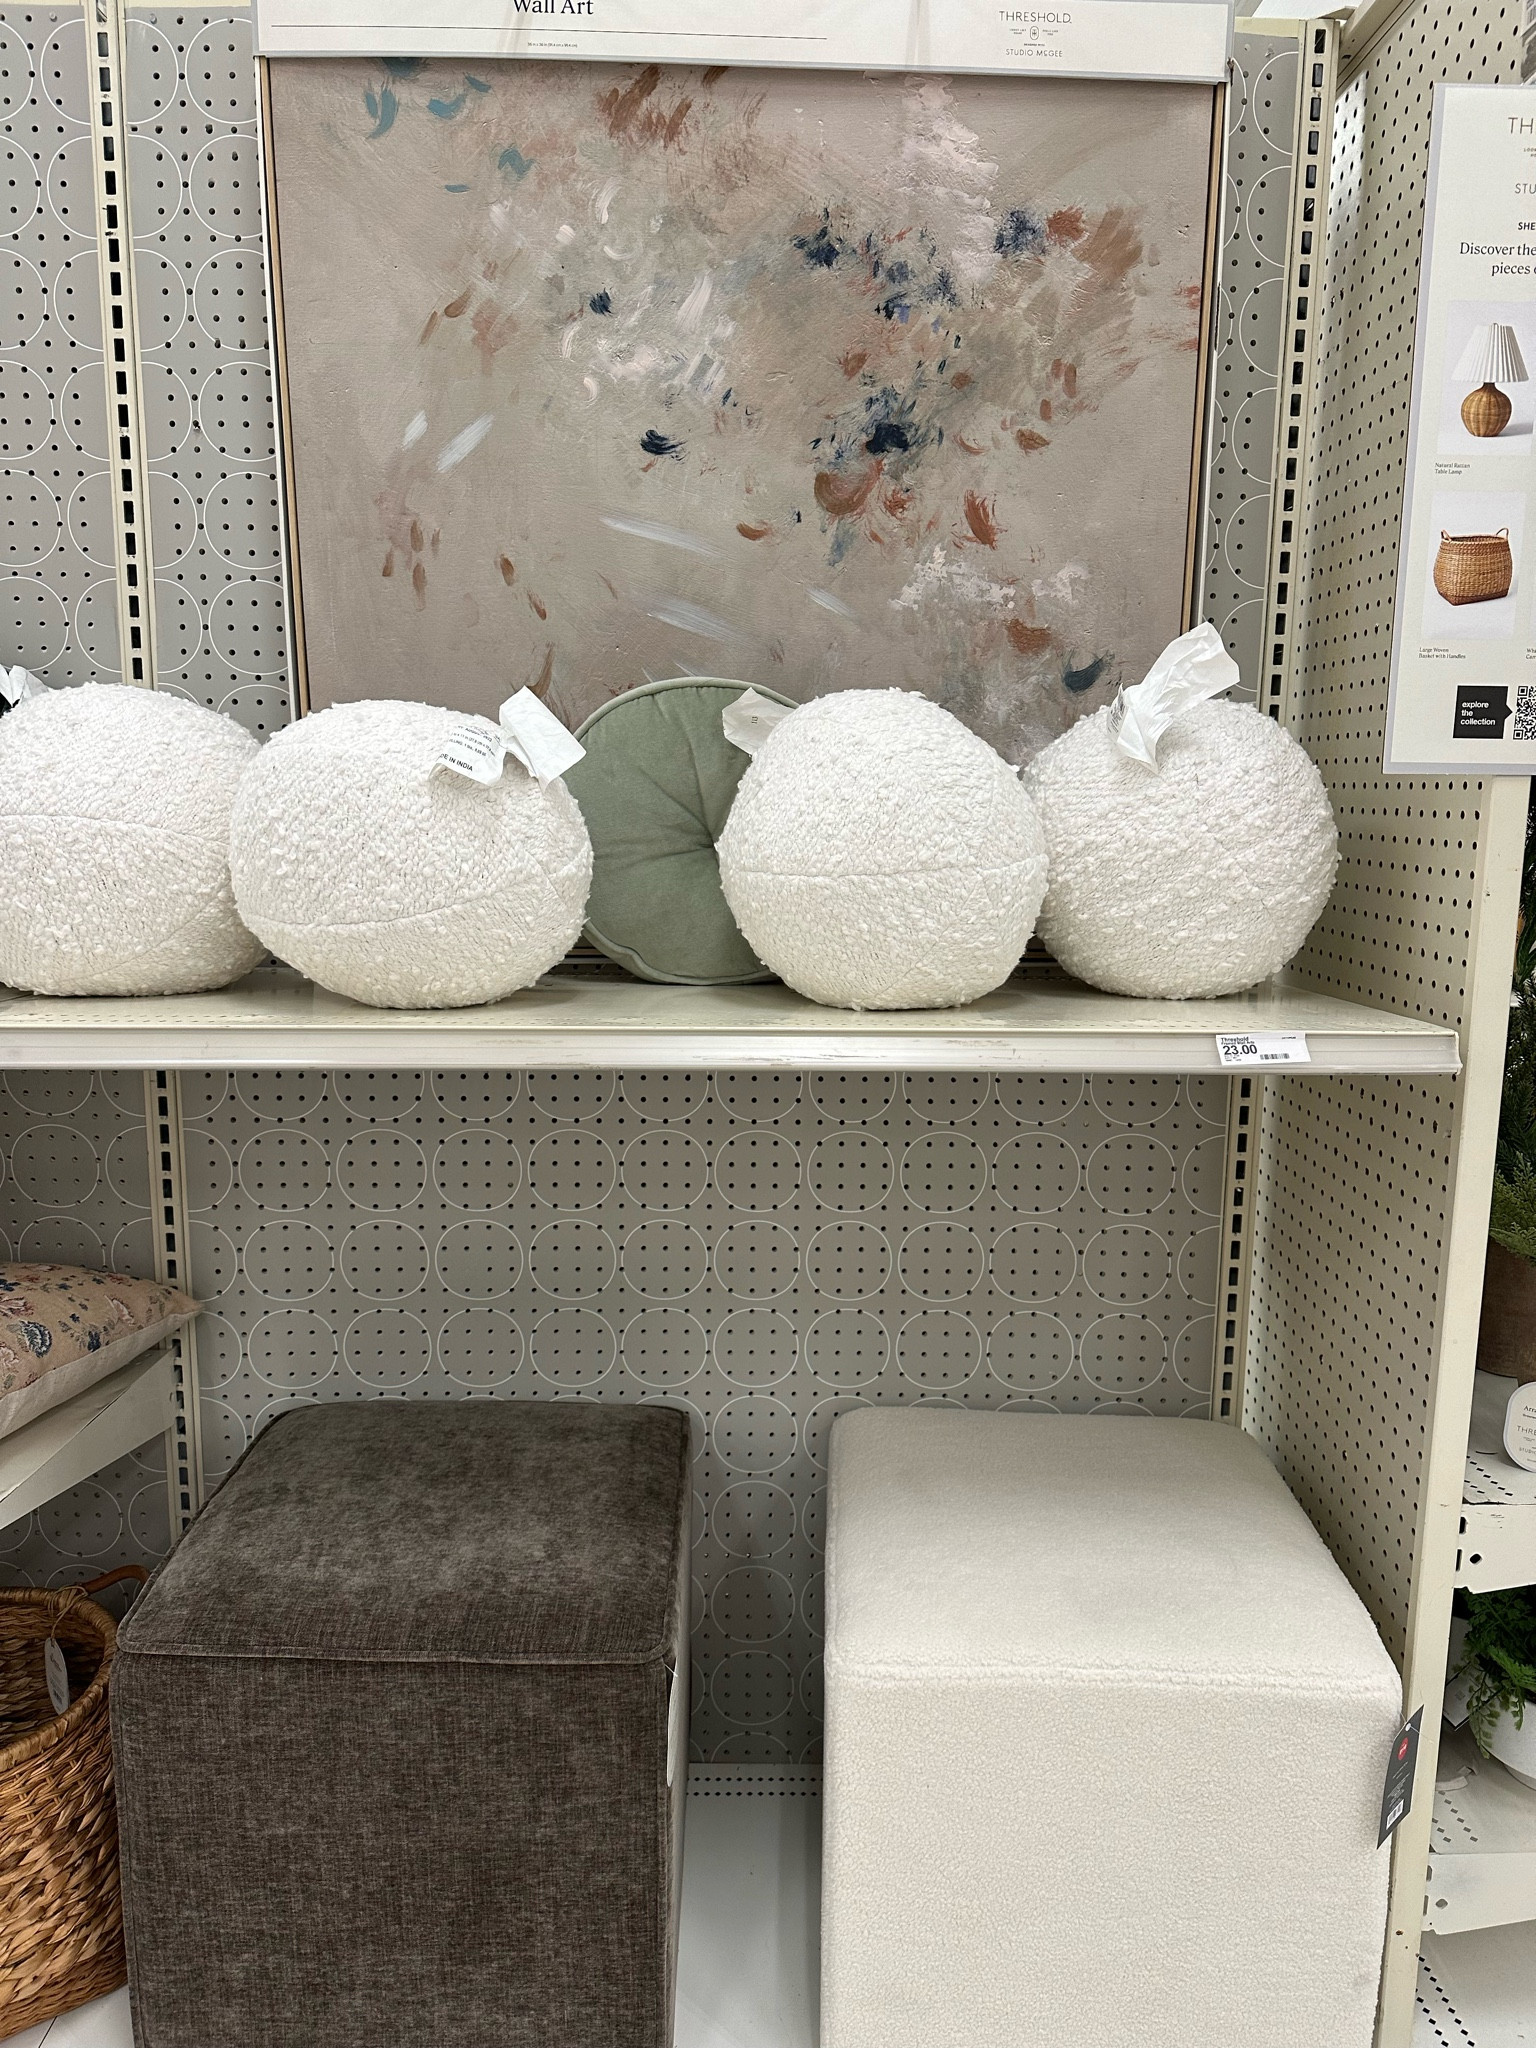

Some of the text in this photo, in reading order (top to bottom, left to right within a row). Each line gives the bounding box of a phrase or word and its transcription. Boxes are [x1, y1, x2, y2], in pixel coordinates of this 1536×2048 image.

[513, 0, 594, 15] Wall Art
[1005, 48, 1033, 56] STUDIO
[1459, 241, 1536, 256] Discover the
[1491, 261, 1531, 276] pieces
[1461, 701, 1489, 709] explore
[1461, 709, 1474, 717] the
[456, 760, 473, 771] INDIA
[1223, 1044, 1257, 1056] 23.00
